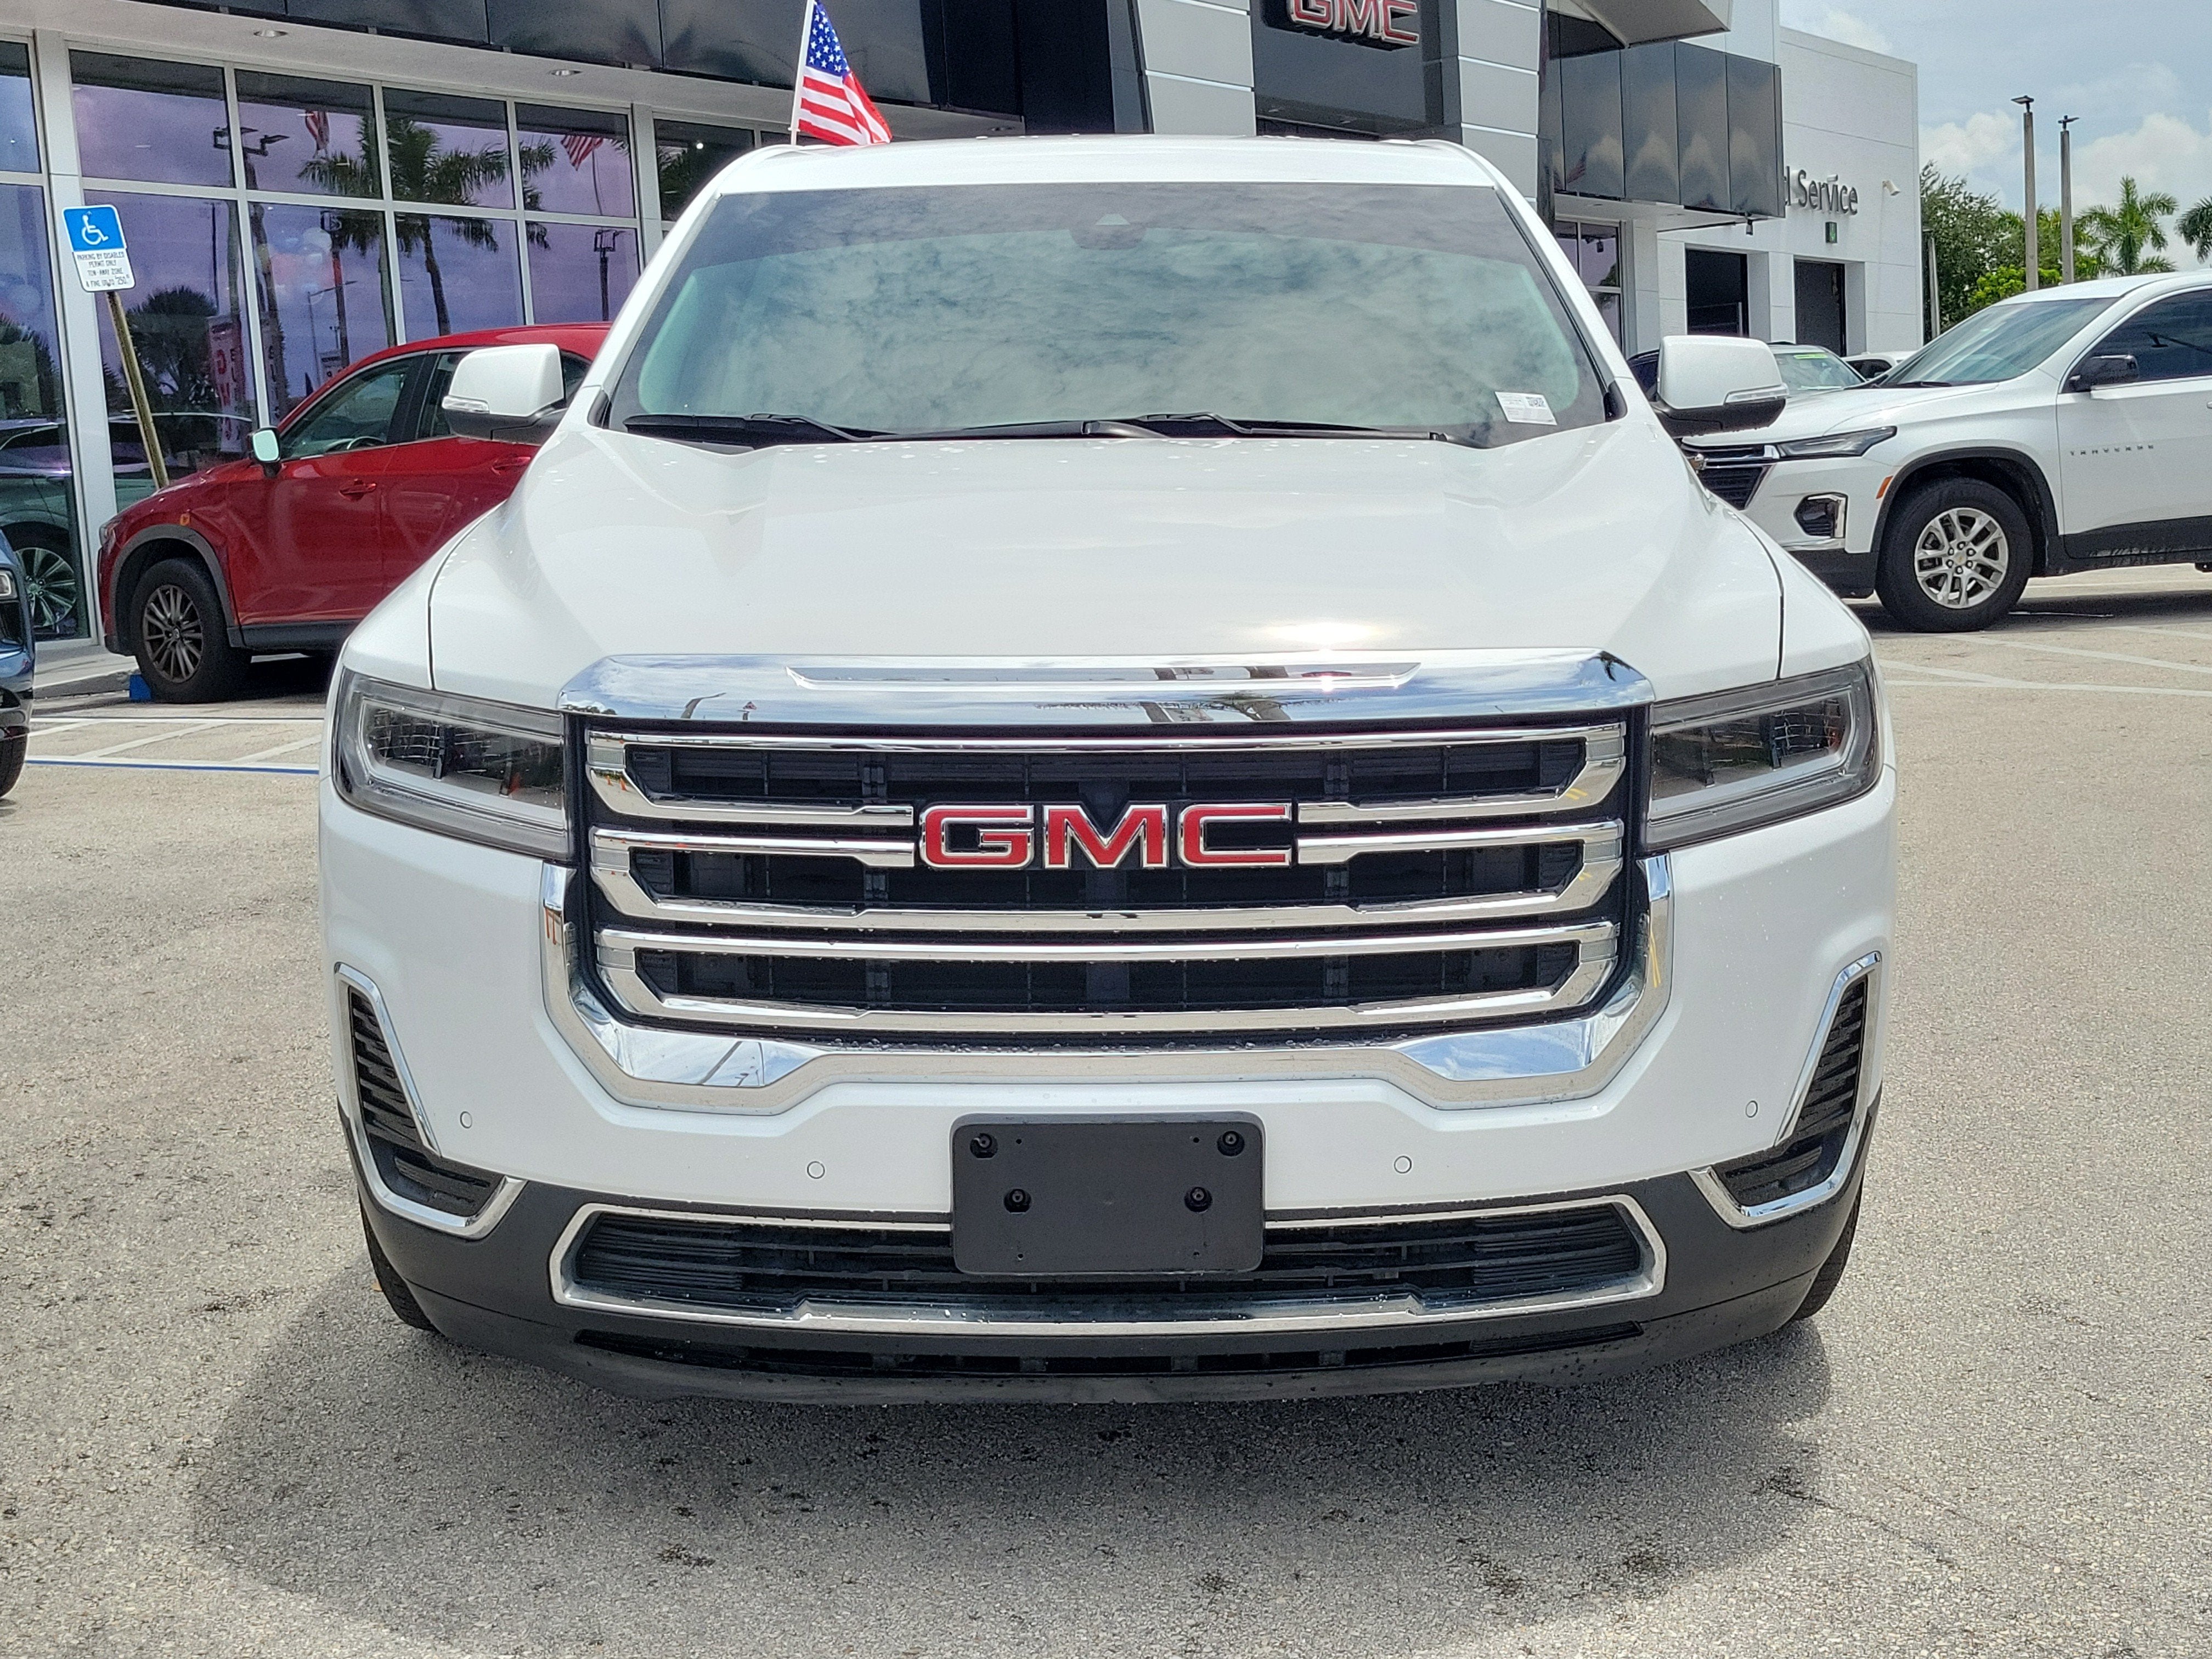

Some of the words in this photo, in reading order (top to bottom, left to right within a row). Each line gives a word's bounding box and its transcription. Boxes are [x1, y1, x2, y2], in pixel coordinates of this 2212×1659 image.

[1292, 0, 1419, 44] GMC
[1798, 169, 1858, 215] Service
[2070, 444, 2154, 456] TRAVERSE
[918, 803, 1293, 870] GMC
